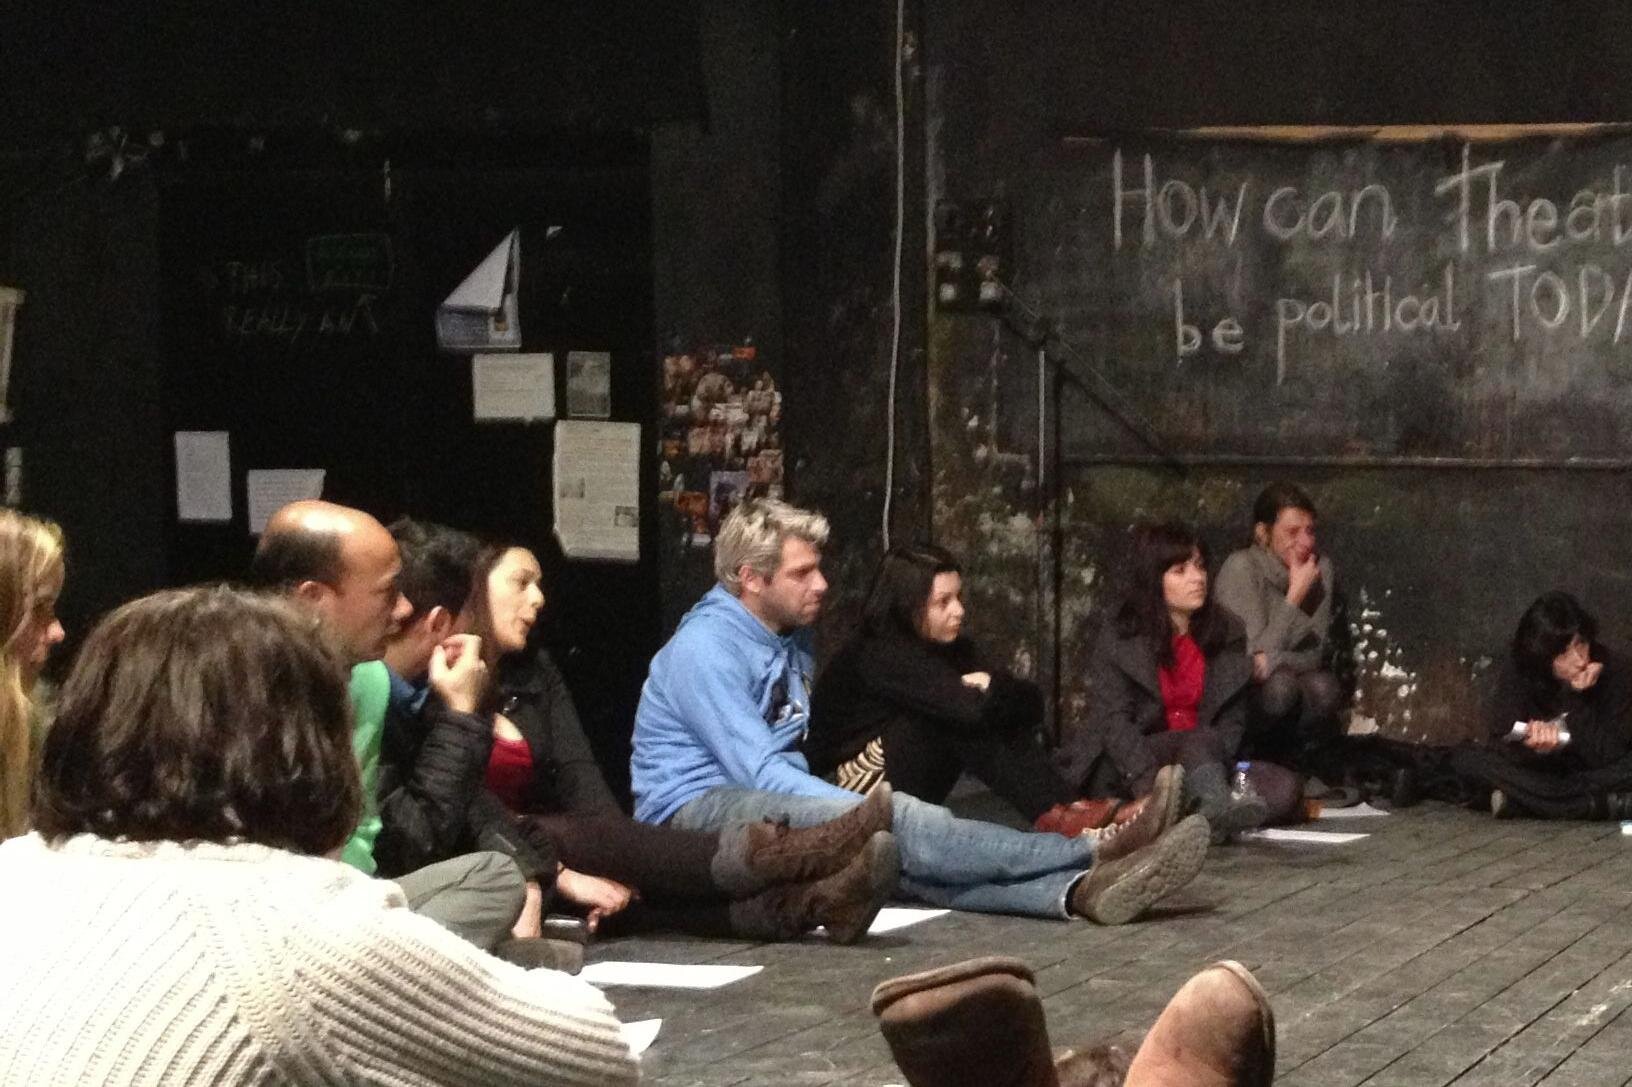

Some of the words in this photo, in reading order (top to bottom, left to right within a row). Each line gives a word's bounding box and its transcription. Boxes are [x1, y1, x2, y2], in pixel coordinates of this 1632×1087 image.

[1112, 147, 1248, 251] How
[1262, 184, 1398, 242] can
[1174, 278, 1245, 360] be
[1276, 261, 1462, 386] political
